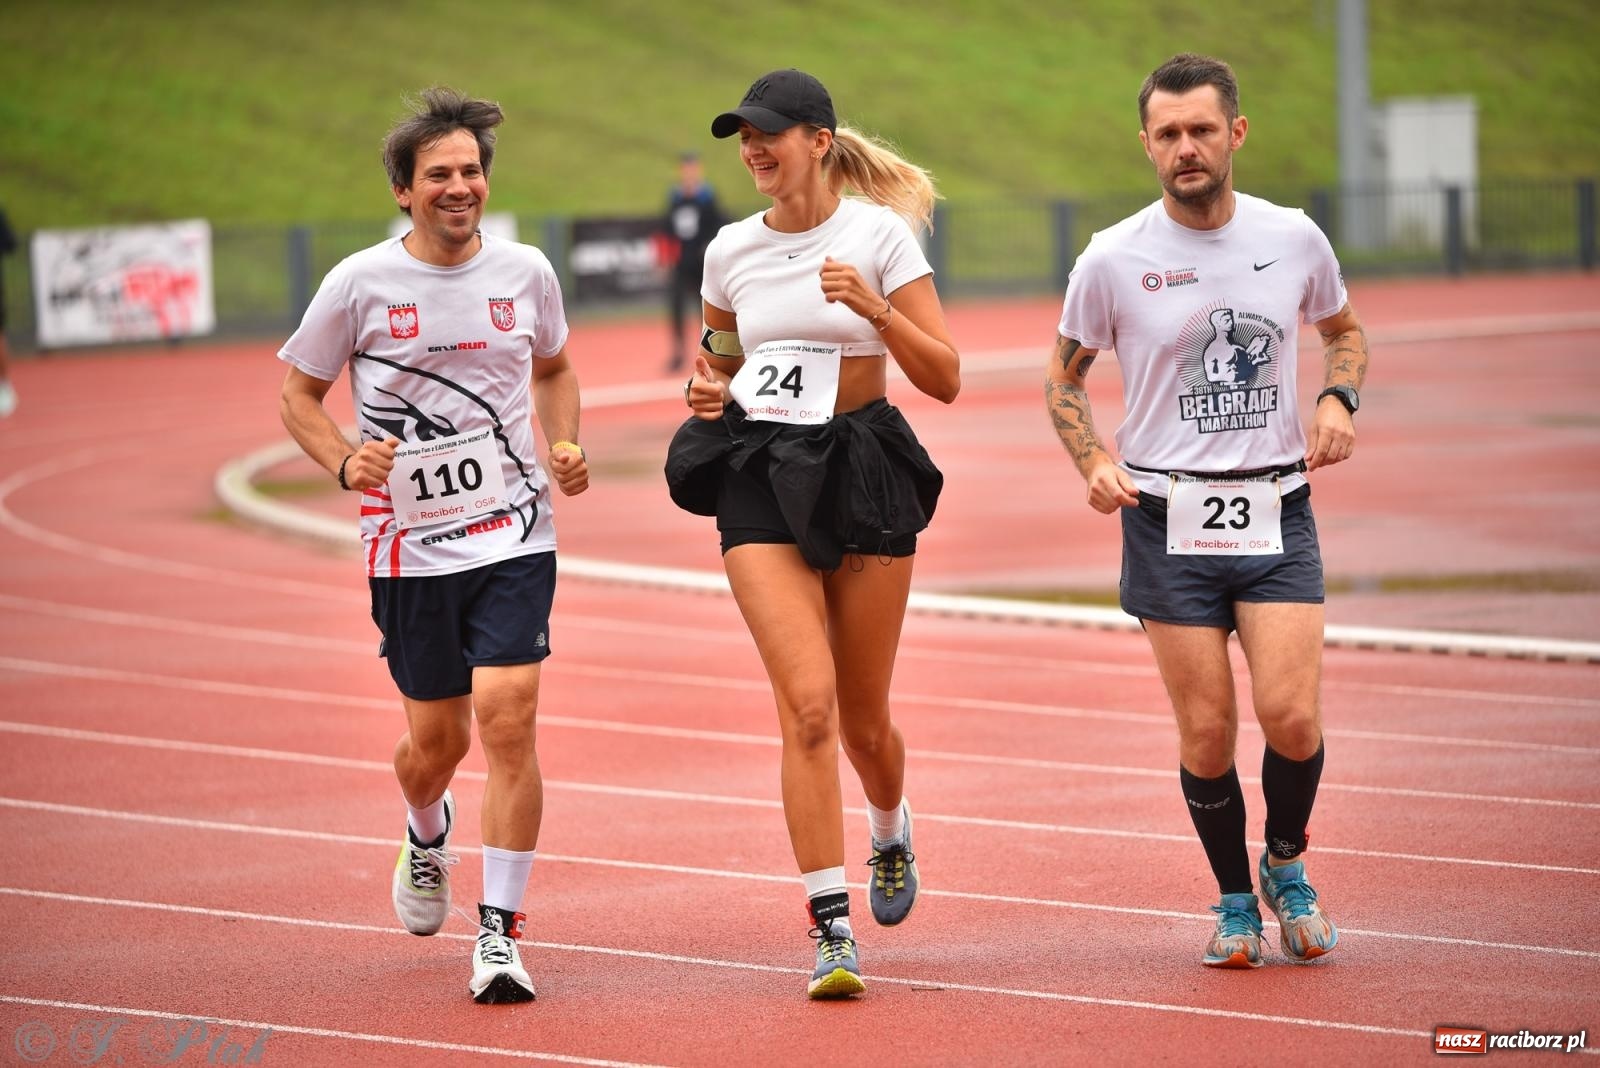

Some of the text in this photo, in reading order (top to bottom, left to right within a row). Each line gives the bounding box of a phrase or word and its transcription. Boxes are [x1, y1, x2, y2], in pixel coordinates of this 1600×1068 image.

[1166, 272, 1194, 281] BELGRADE
[1167, 278, 1199, 288] MARATHON
[1238, 312, 1262, 321] ALWAYS
[1263, 317, 1278, 331] MORE
[755, 364, 803, 398] 24
[748, 405, 789, 417] Racibórz
[1181, 387, 1277, 419] BELGRADE
[1200, 412, 1266, 432] MARATHON
[409, 458, 483, 501] 110
[420, 496, 497, 520] Racibórz OSiR
[1202, 496, 1250, 530] 23
[1194, 538, 1270, 549] Racibórz OSiR
